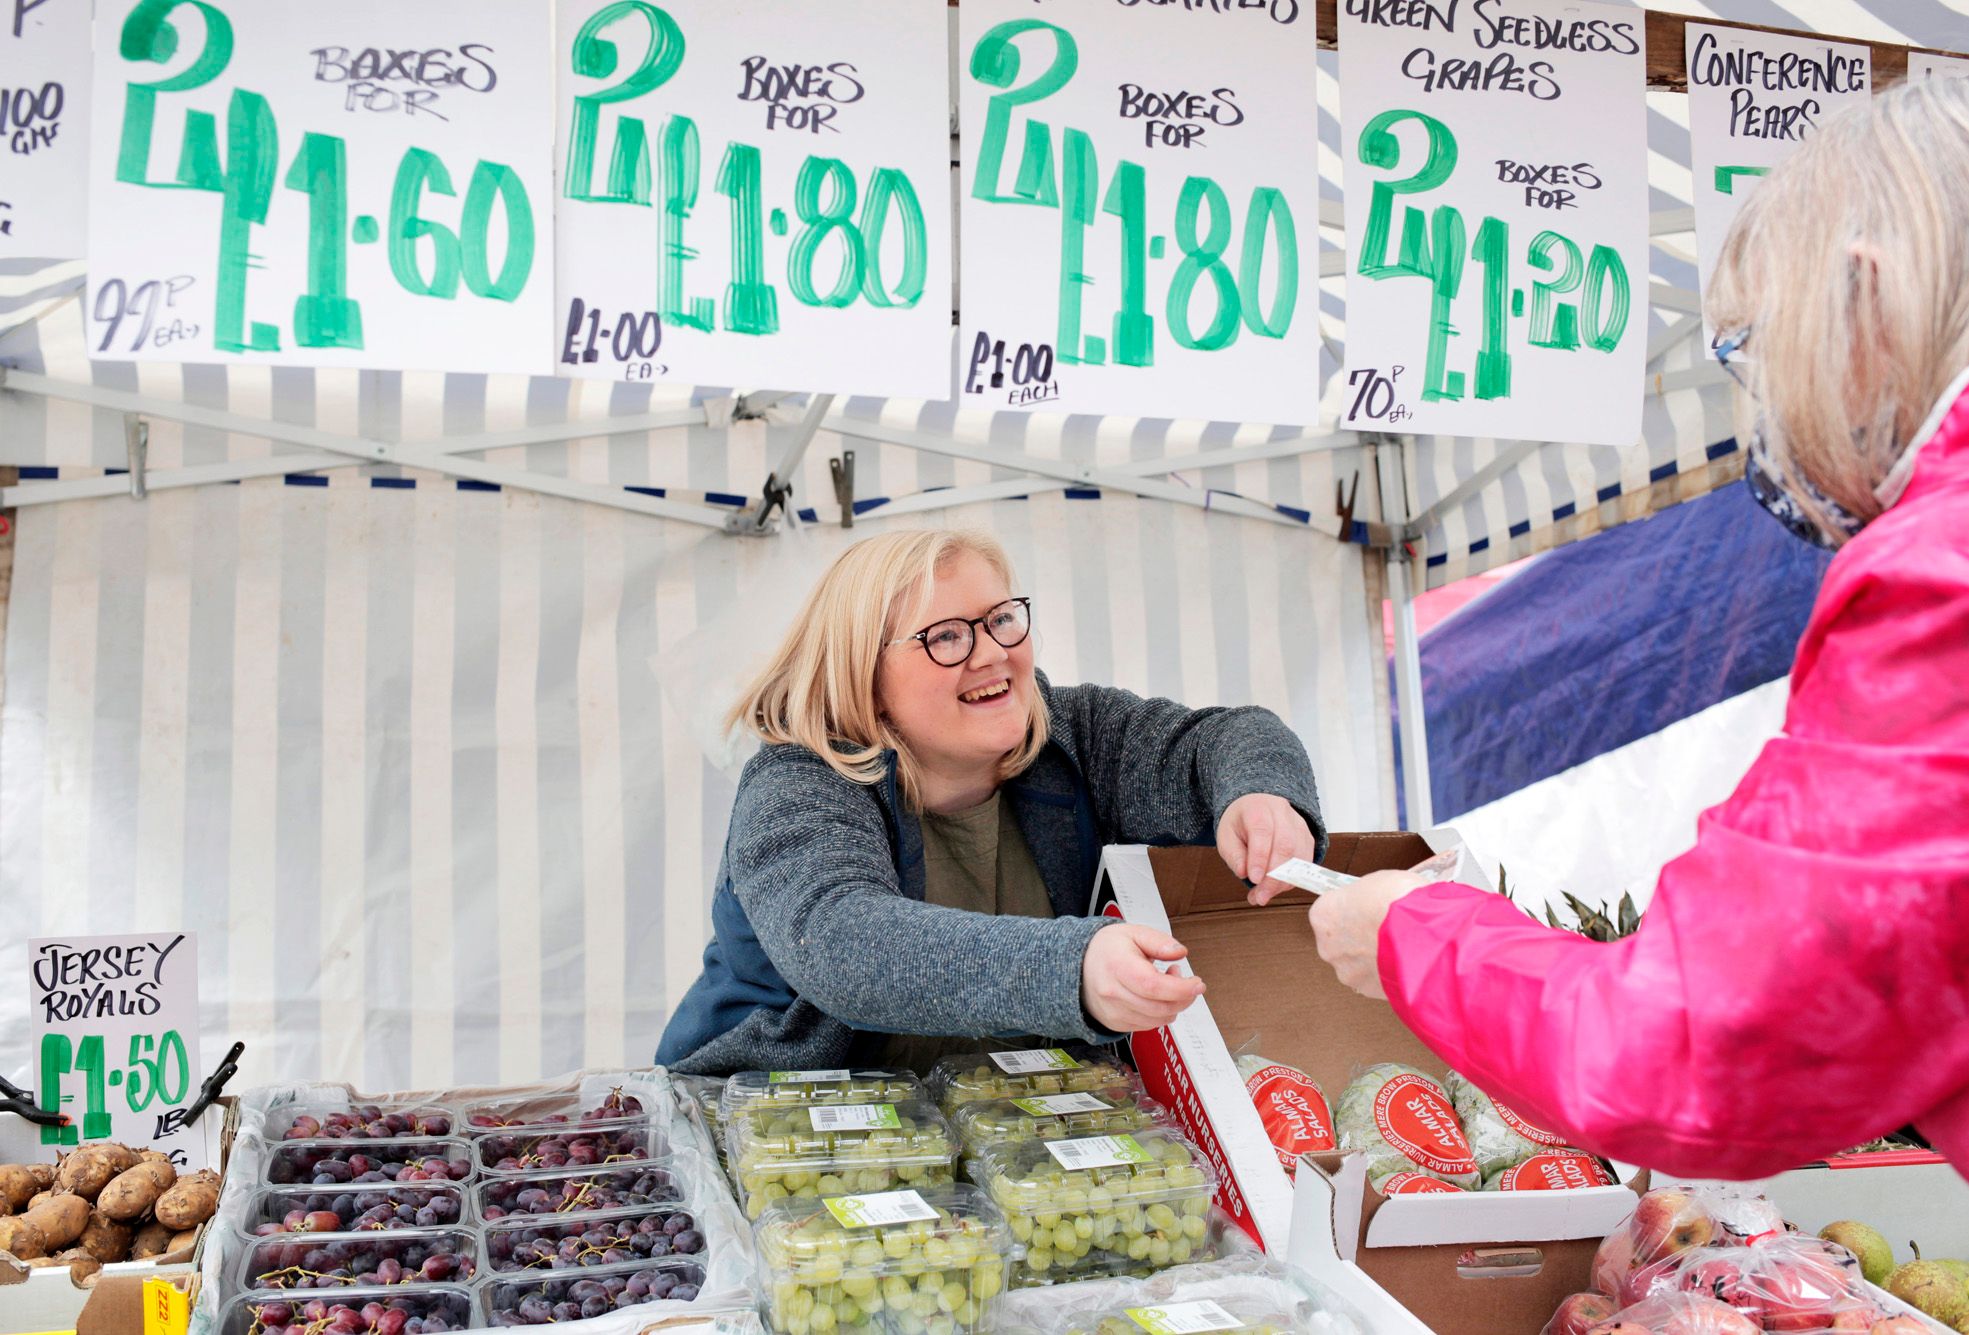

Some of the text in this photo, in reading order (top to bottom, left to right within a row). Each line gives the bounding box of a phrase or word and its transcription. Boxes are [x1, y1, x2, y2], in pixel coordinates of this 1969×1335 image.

[1473, 0, 1640, 55] SEEDLESS
[310, 44, 498, 93] BOXES
[737, 56, 865, 103] BOXES
[1401, 48, 1561, 100] GRAPES
[1691, 33, 1865, 94] CONFERENCE
[345, 83, 450, 122] FOR
[564, 0, 686, 208] 2
[766, 103, 840, 134] FOR
[970, 18, 1079, 209] 2
[1118, 84, 1244, 126] BOXES
[1730, 88, 1820, 142] PEARS
[1145, 120, 1207, 148] FOR
[1358, 109, 1458, 281] 2
[1495, 159, 1602, 190] BOXES
[1525, 187, 1578, 210] FOR
[1008, 380, 1060, 405] EACH
[33, 934, 186, 992] JERSEY
[40, 982, 161, 1024] ROYALS
[1163, 1062, 1176, 1096] The
[1262, 1067, 1303, 1083] PRESTON
[1377, 1081, 1398, 1105] BROW
[1157, 1025, 1243, 1218] ALMAR NURSERIES
[1270, 1092, 1311, 1140] ALMAR
[1283, 1089, 1328, 1138] SALADS
[1376, 1105, 1388, 1128] MERE
[1406, 1097, 1455, 1147] ALMAR
[1382, 1130, 1428, 1167] NURSERIES
[1427, 1160, 1464, 1173] ALMAR
